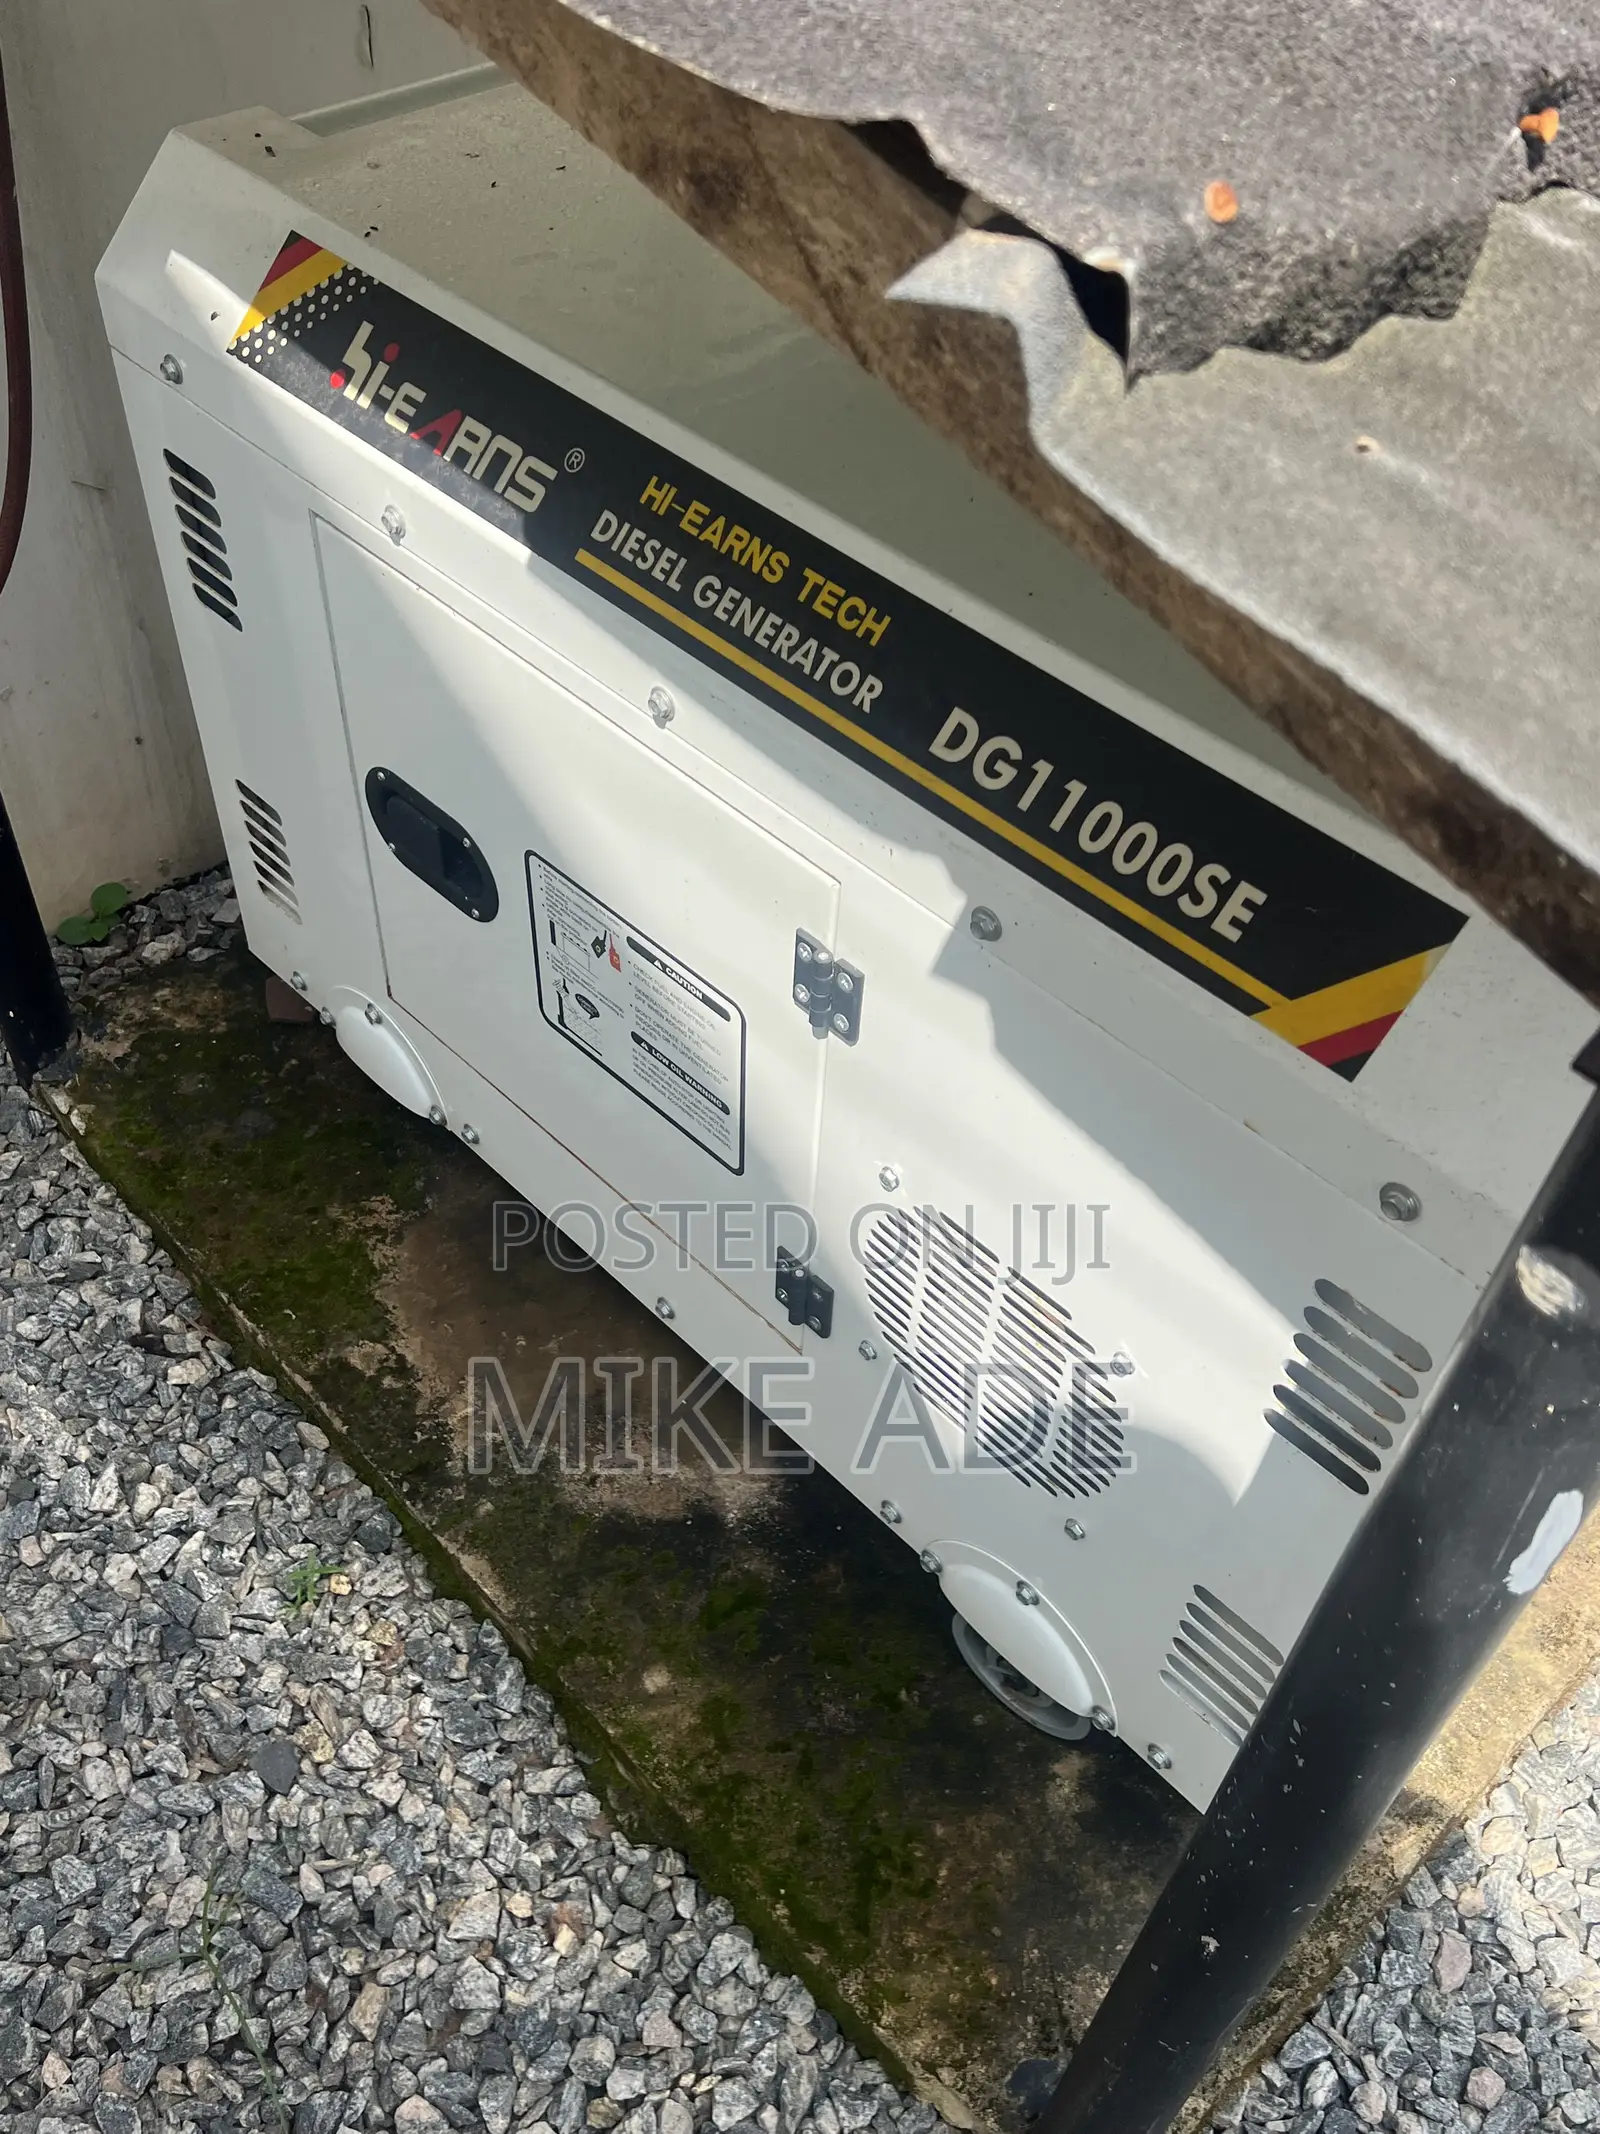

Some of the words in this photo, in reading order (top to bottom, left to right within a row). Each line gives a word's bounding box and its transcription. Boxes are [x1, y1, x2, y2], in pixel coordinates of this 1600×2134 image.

[590, 509, 688, 592] DIESEL
[693, 575, 883, 714] GENERATOR
[639, 475, 791, 584] HI-EARNS
[797, 567, 892, 647] TECH
[928, 706, 1268, 943] DG11000SE
[665, 966, 702, 1000] CAUTION
[652, 1048, 669, 1066] LOW
[670, 1062, 683, 1078] OIL
[684, 1074, 722, 1109] WARNING
